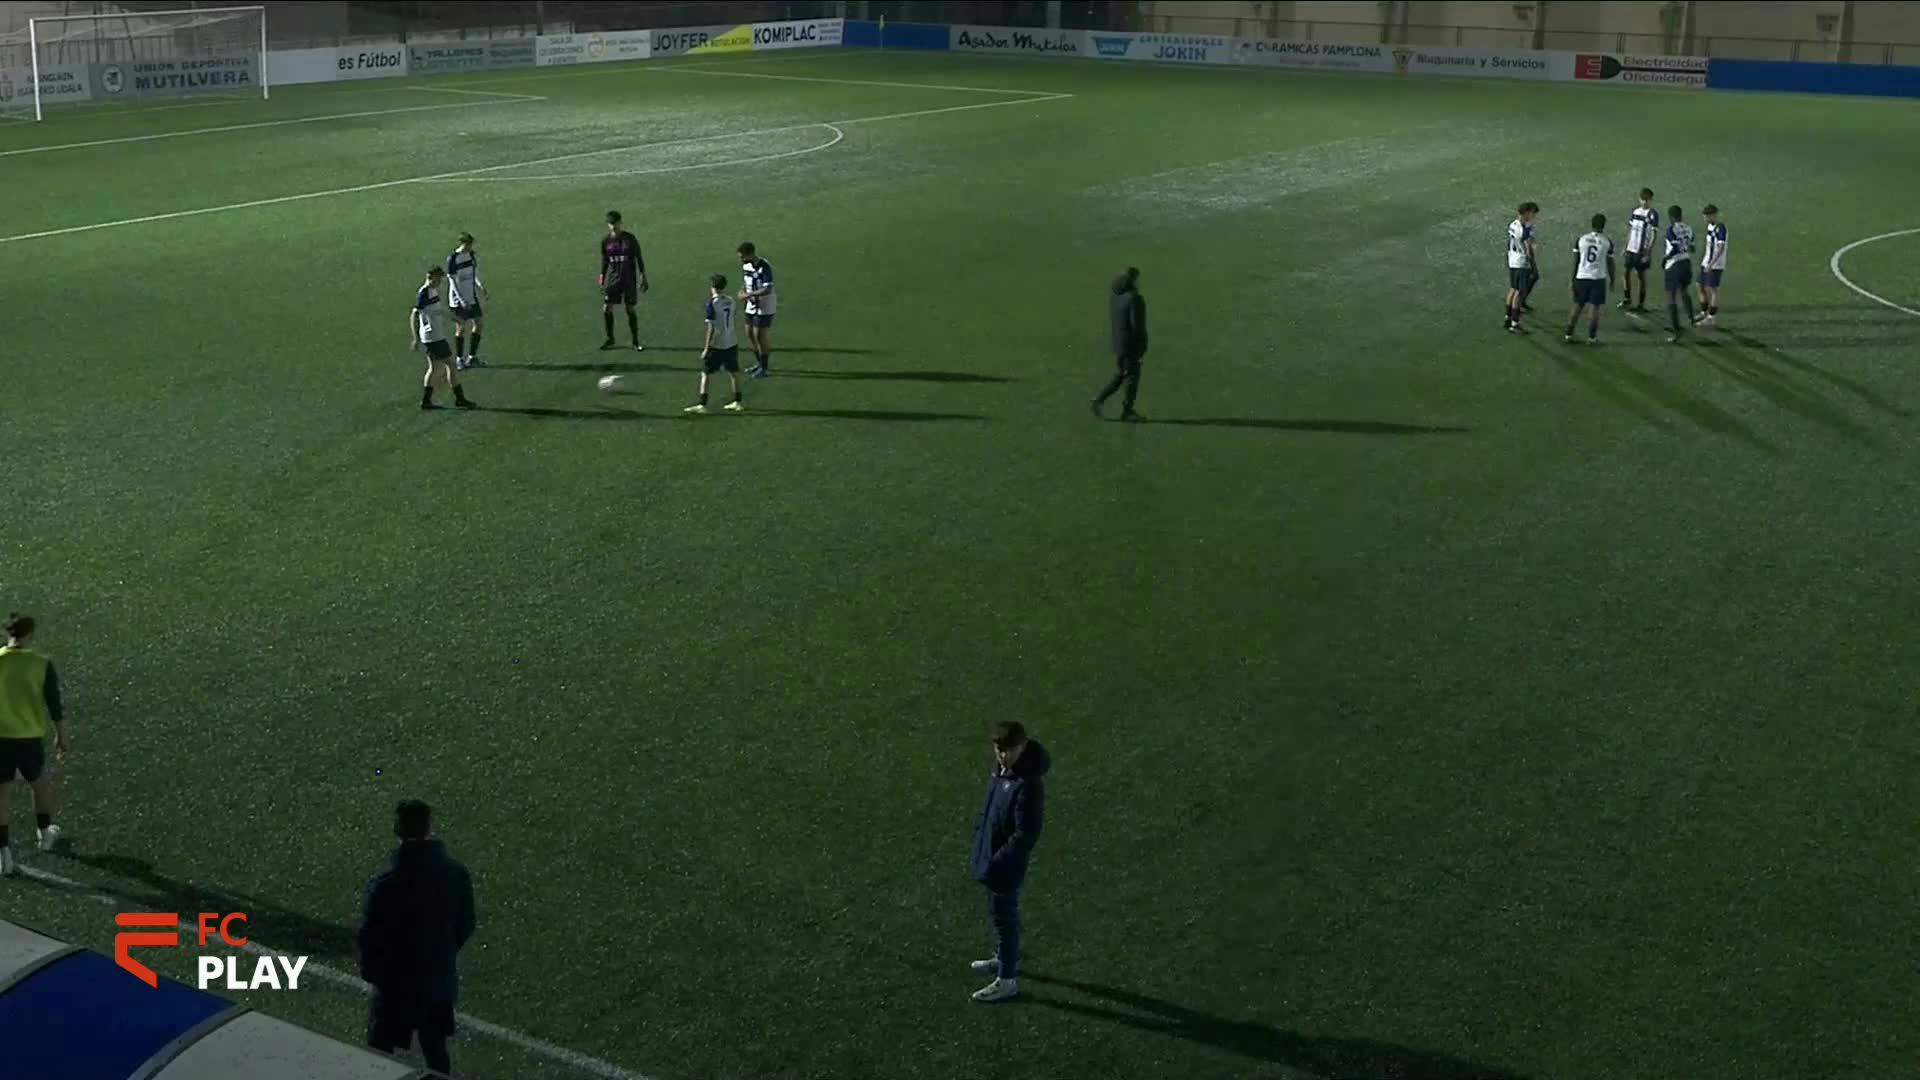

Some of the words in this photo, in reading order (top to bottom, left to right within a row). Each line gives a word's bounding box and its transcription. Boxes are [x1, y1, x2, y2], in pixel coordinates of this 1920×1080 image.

[653, 33, 710, 51] JOYFER
[753, 24, 816, 45] KOMIPLAC
[957, 31, 1009, 49] Asador
[1153, 46, 1207, 61] JOKIN
[1322, 44, 1382, 57] PAMPLONA
[182, 57, 249, 70] DEPORTIVA
[338, 56, 353, 70] es
[357, 51, 401, 69] Fútbol
[1479, 56, 1488, 69] y
[1491, 56, 1546, 69] Servicios
[135, 70, 249, 89] MUTILVERA
[1622, 71, 1706, 85] Oficialdegu
[1587, 245, 1598, 263] 6
[723, 307, 731, 328] 7
